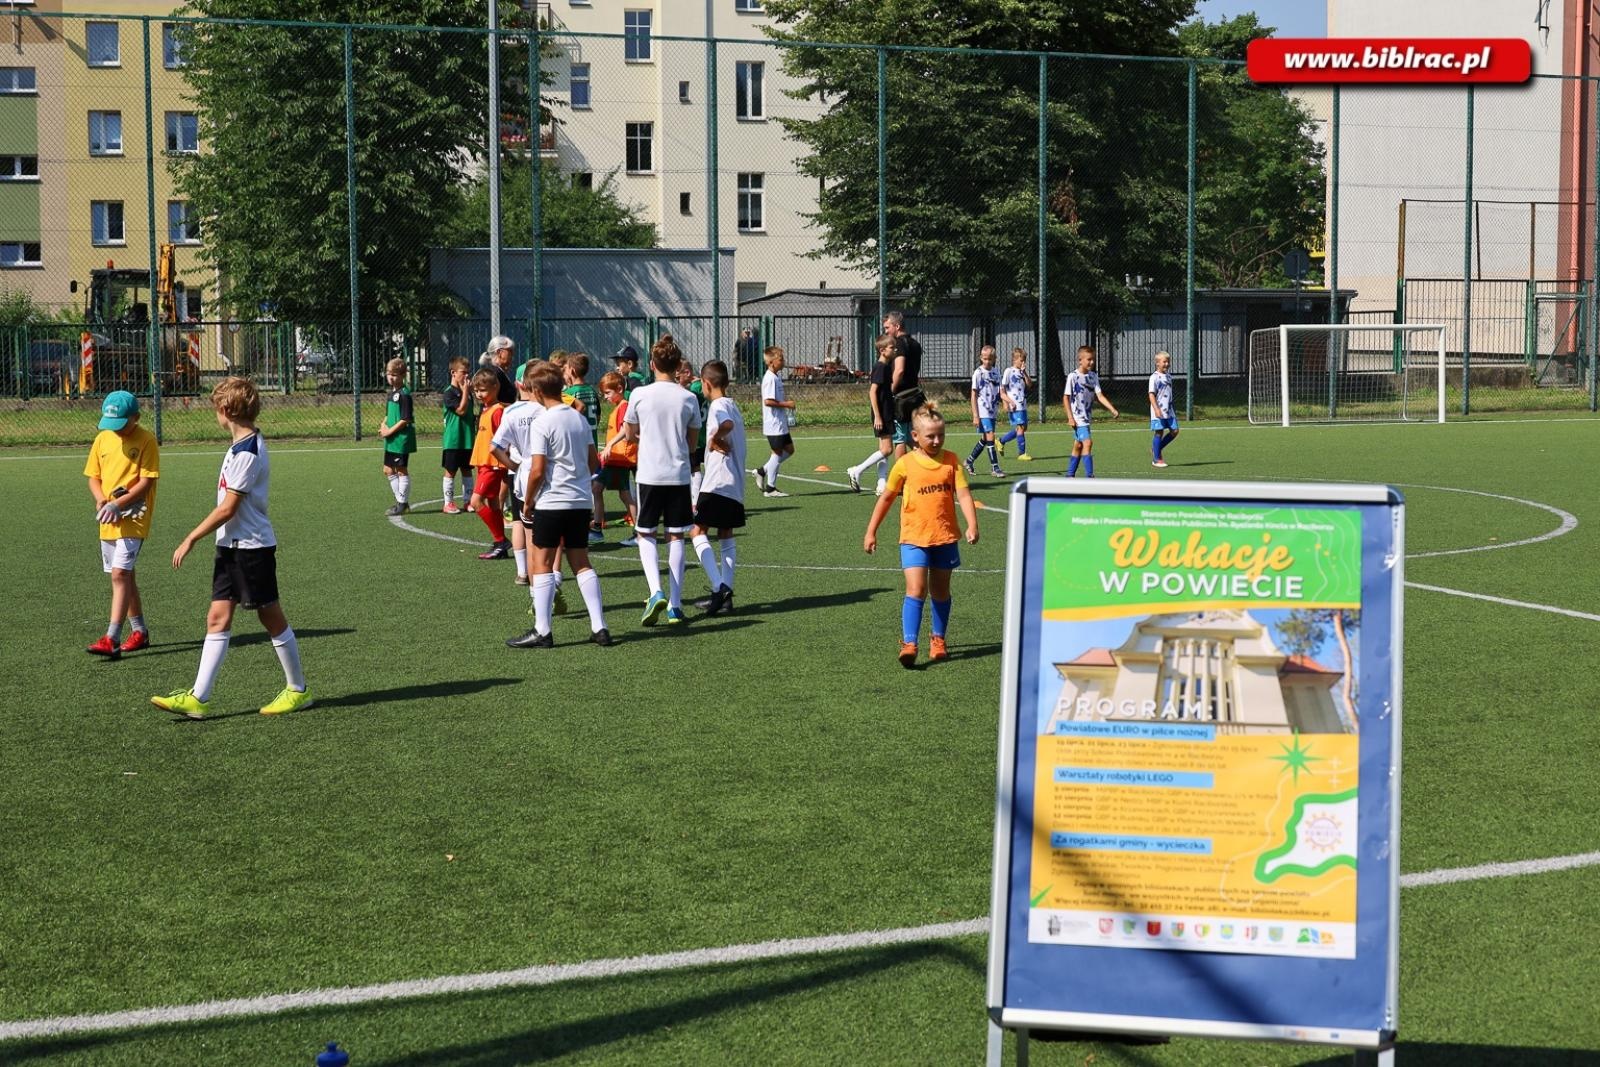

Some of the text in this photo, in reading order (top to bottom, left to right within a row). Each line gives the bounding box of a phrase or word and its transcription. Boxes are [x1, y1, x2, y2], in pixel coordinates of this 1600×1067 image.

[1109, 527, 1294, 582] Wakacje
[1099, 571, 1304, 598] W POWIECIE
[1057, 698, 1213, 720] PROGRAM:
[1060, 723, 1111, 734] Powiatowe
[1113, 724, 1140, 735] EURO
[1058, 769, 1174, 783] Warsztaty robotyki LEGO
[1055, 835, 1067, 844] Za
[1069, 836, 1117, 847] rogatkami
[1119, 839, 1148, 849] gminy
[1156, 840, 1206, 850] wycieczka
